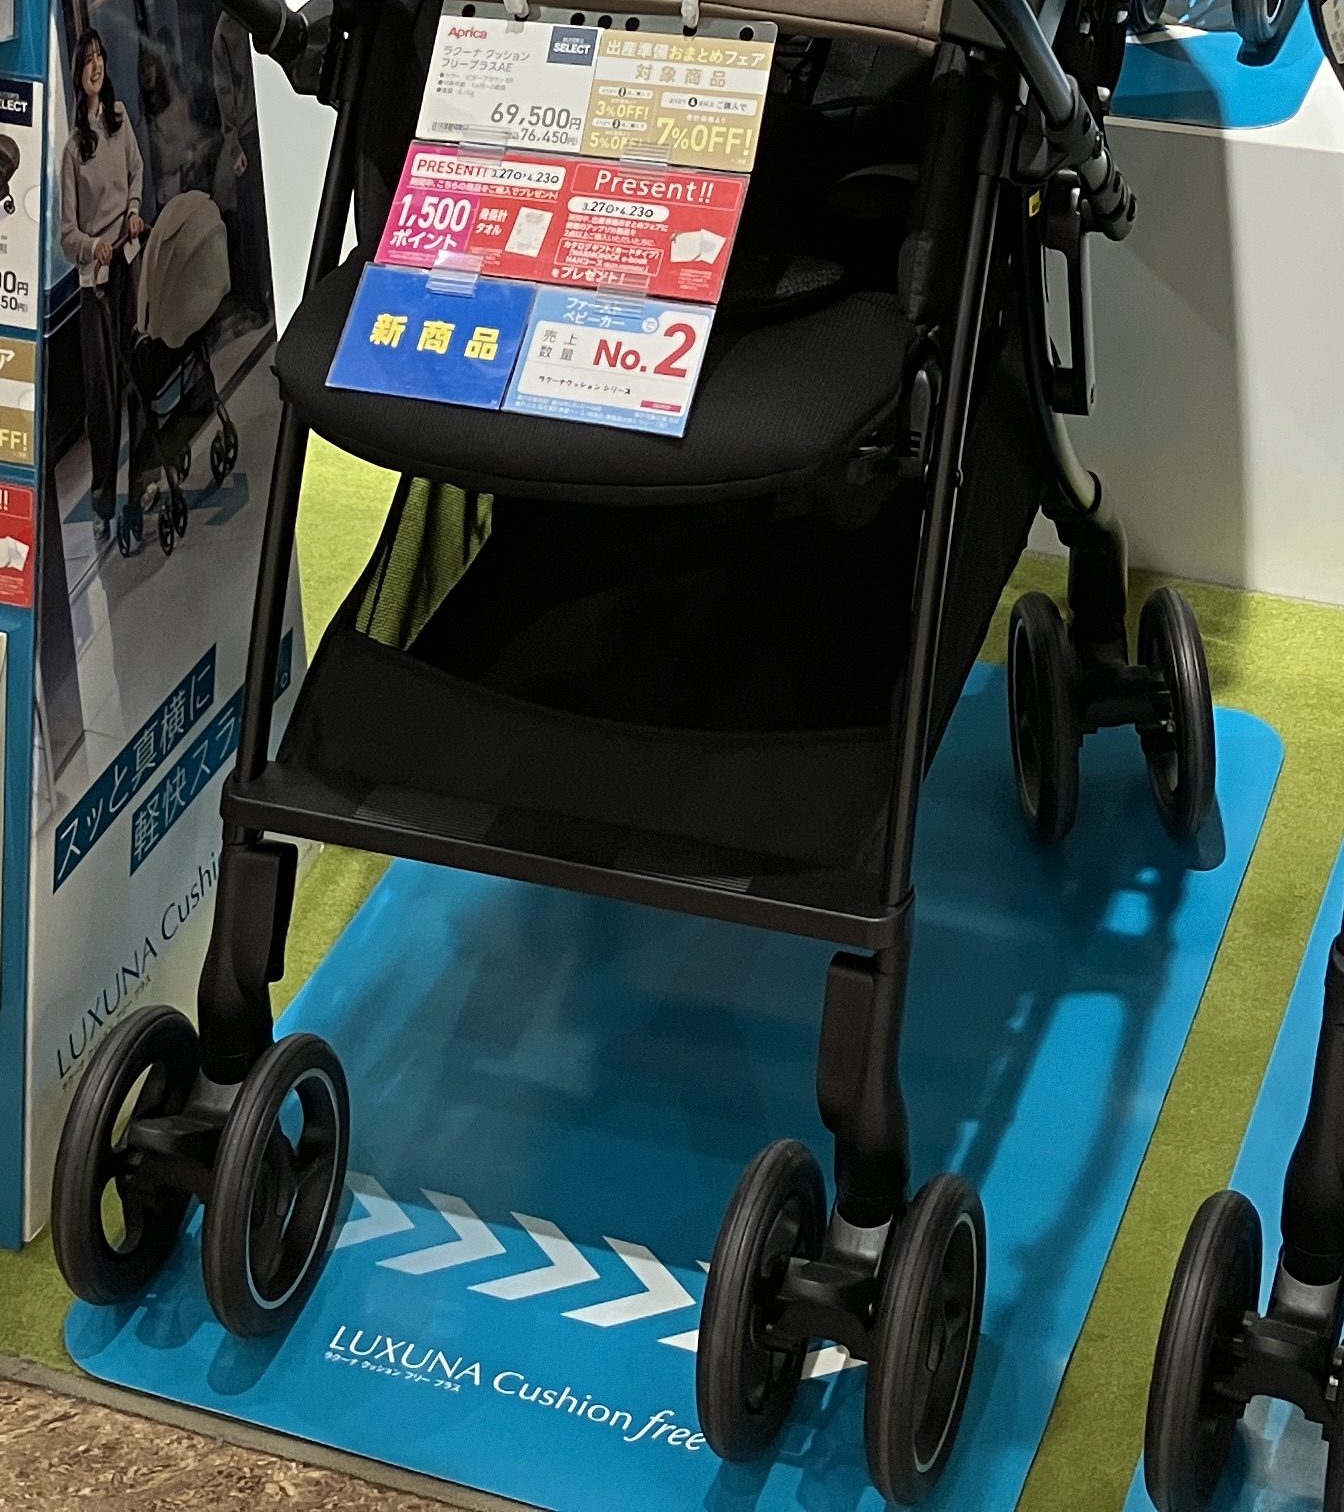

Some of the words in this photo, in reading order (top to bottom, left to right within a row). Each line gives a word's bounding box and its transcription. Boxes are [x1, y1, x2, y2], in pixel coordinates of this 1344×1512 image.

[448, 26, 488, 40] Aprica
[443, 45, 482, 57] ラクーナ
[485, 49, 531, 62] クッション
[553, 42, 592, 55] SELECT
[606, 39, 766, 67] 出産準備おまとめフェア
[442, 58, 514, 73] フリープラスAE
[635, 63, 726, 88] 対象商品
[490, 102, 582, 131] 69,500円
[595, 100, 649, 120] 3%OFF!
[656, 117, 753, 156] 7%OFF!
[416, 159, 487, 178] PRESENT!
[594, 169, 714, 204] Present!!
[398, 193, 471, 232] 1,500
[479, 207, 508, 223] 身長計
[390, 228, 457, 251] ポイント
[475, 223, 503, 237] タオル
[369, 313, 499, 361] 新商品
[543, 329, 578, 346] 売上
[538, 345, 574, 361] 数量
[593, 323, 696, 378] No.2
[57, 664, 211, 880] スッと真横に
[56, 936, 158, 1079] LUXUNA
[161, 852, 219, 940] Cushi
[324, 1350, 359, 1367] ラクーナ
[360, 1362, 401, 1376] クッション
[404, 1371, 431, 1384] フリー
[434, 1378, 462, 1393] プラス
[329, 1325, 482, 1387] LUXUNA
[493, 1370, 632, 1430] Cushion
[624, 1409, 708, 1451] free
